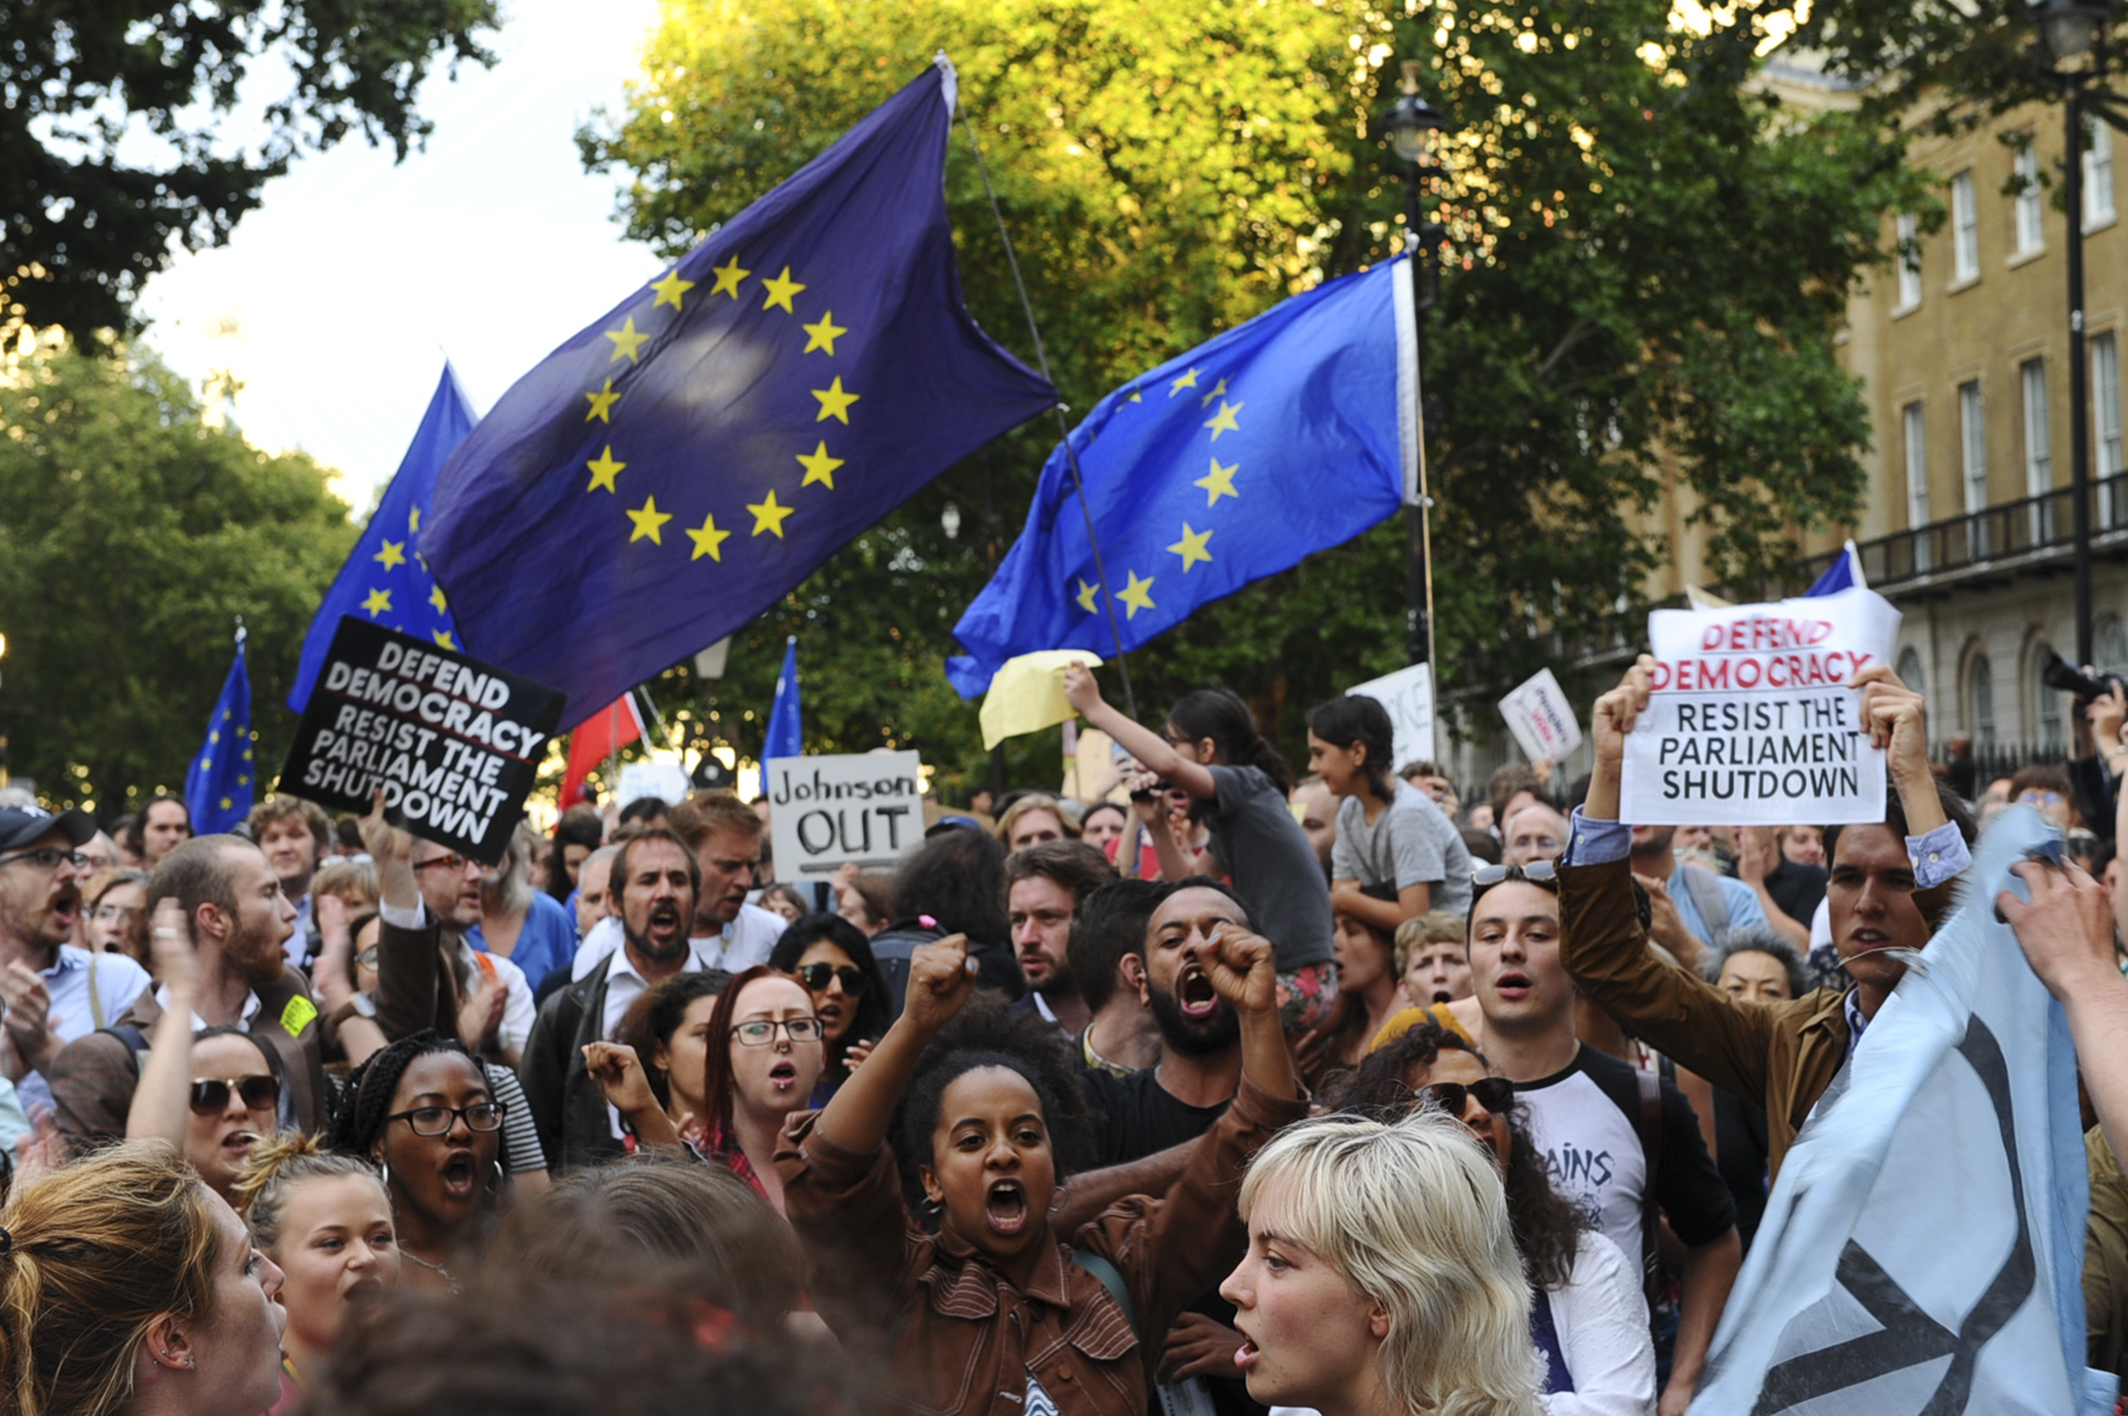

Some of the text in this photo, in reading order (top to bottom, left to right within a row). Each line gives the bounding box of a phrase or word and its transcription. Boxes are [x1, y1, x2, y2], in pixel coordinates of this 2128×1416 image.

[1703, 618, 1834, 650] DEFEND
[377, 641, 510, 710] DEFEND
[1650, 651, 1873, 687] DEMOCRACY
[325, 661, 545, 759] DEMOCRACY
[1677, 696, 1846, 732] RESIST THE
[335, 705, 505, 786] RESIST THE
[1659, 731, 1858, 765] PARLIAMENT
[311, 729, 508, 817] PARLIAMENT
[774, 769, 916, 806] Johnson
[1663, 767, 1858, 799] SHUTDOWN
[304, 758, 490, 845] SHUTDOWN
[797, 805, 909, 855] OUT
